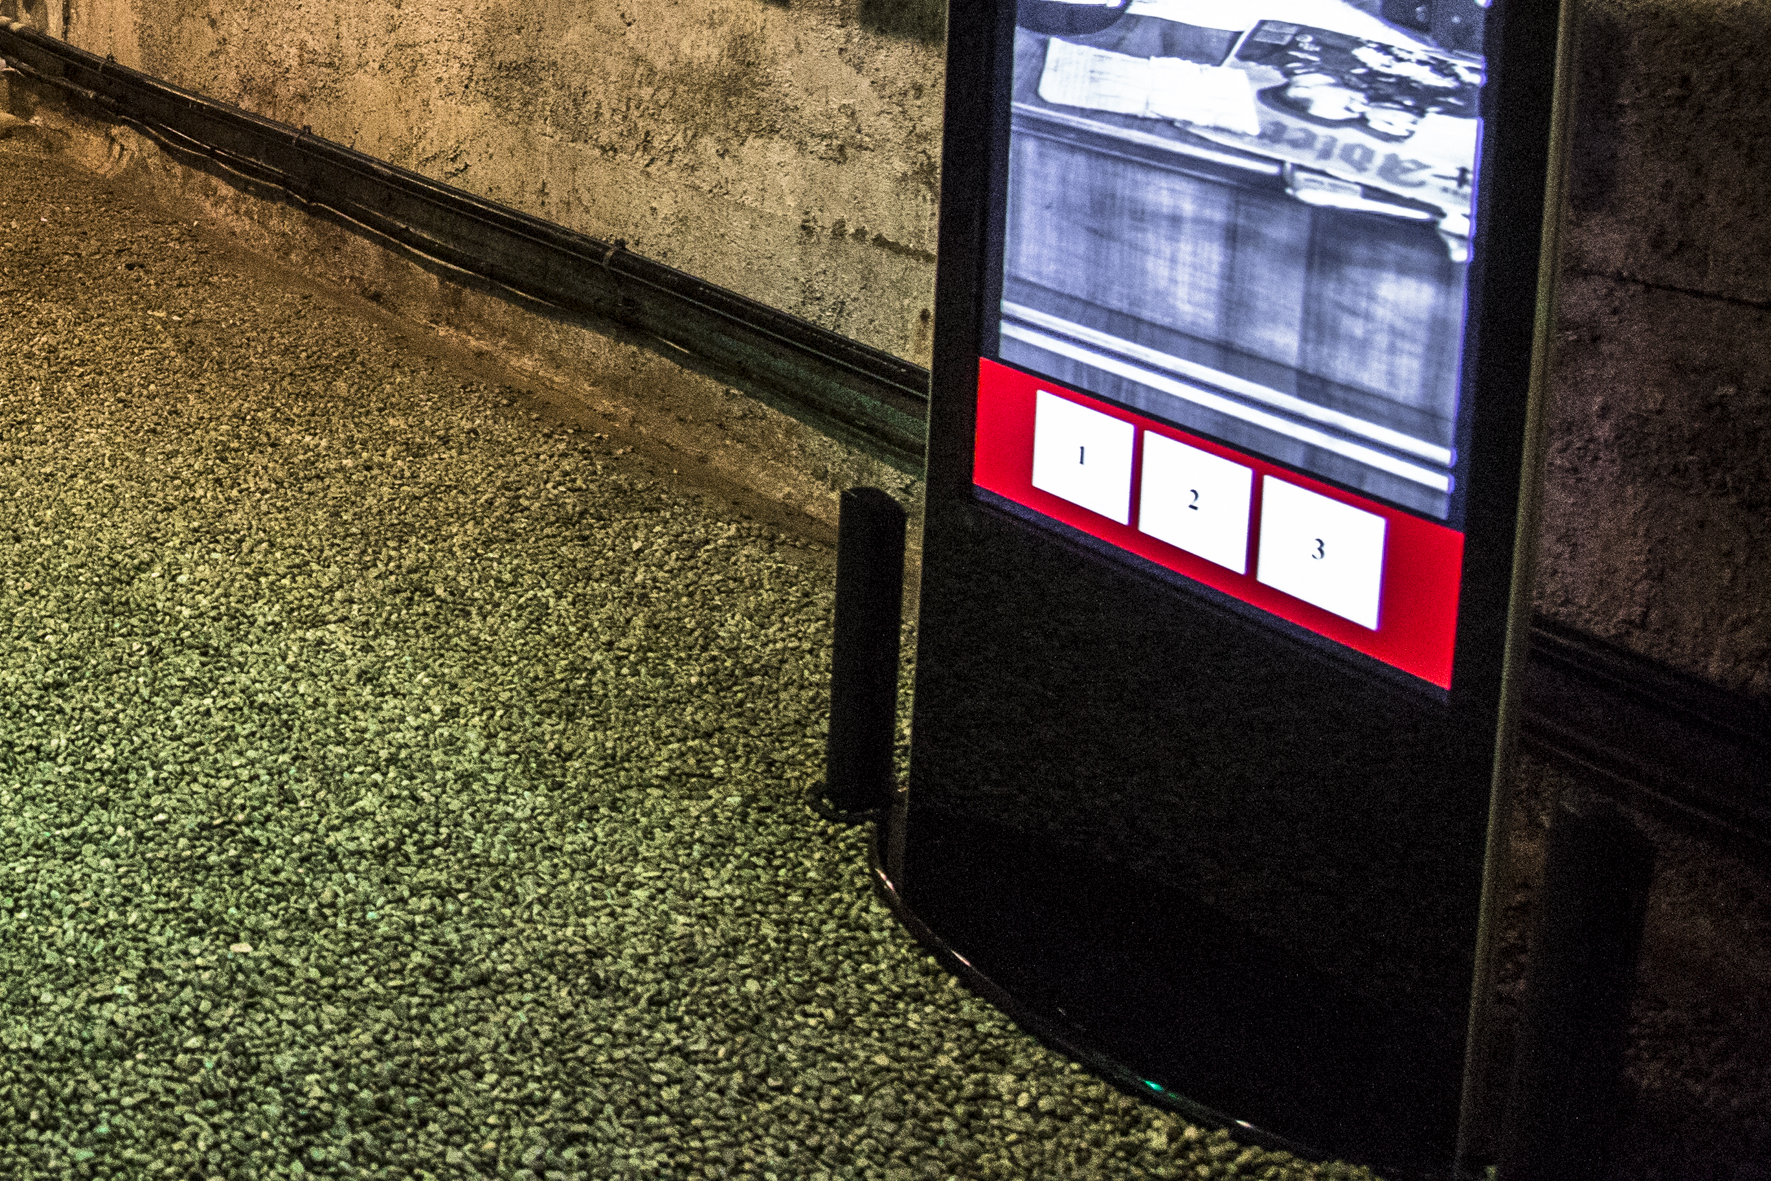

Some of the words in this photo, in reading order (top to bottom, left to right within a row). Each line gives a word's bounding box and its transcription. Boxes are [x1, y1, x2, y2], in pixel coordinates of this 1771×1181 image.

[1079, 446, 1086, 465] 1
[1188, 490, 1199, 510] 2
[1312, 539, 1325, 560] 3
